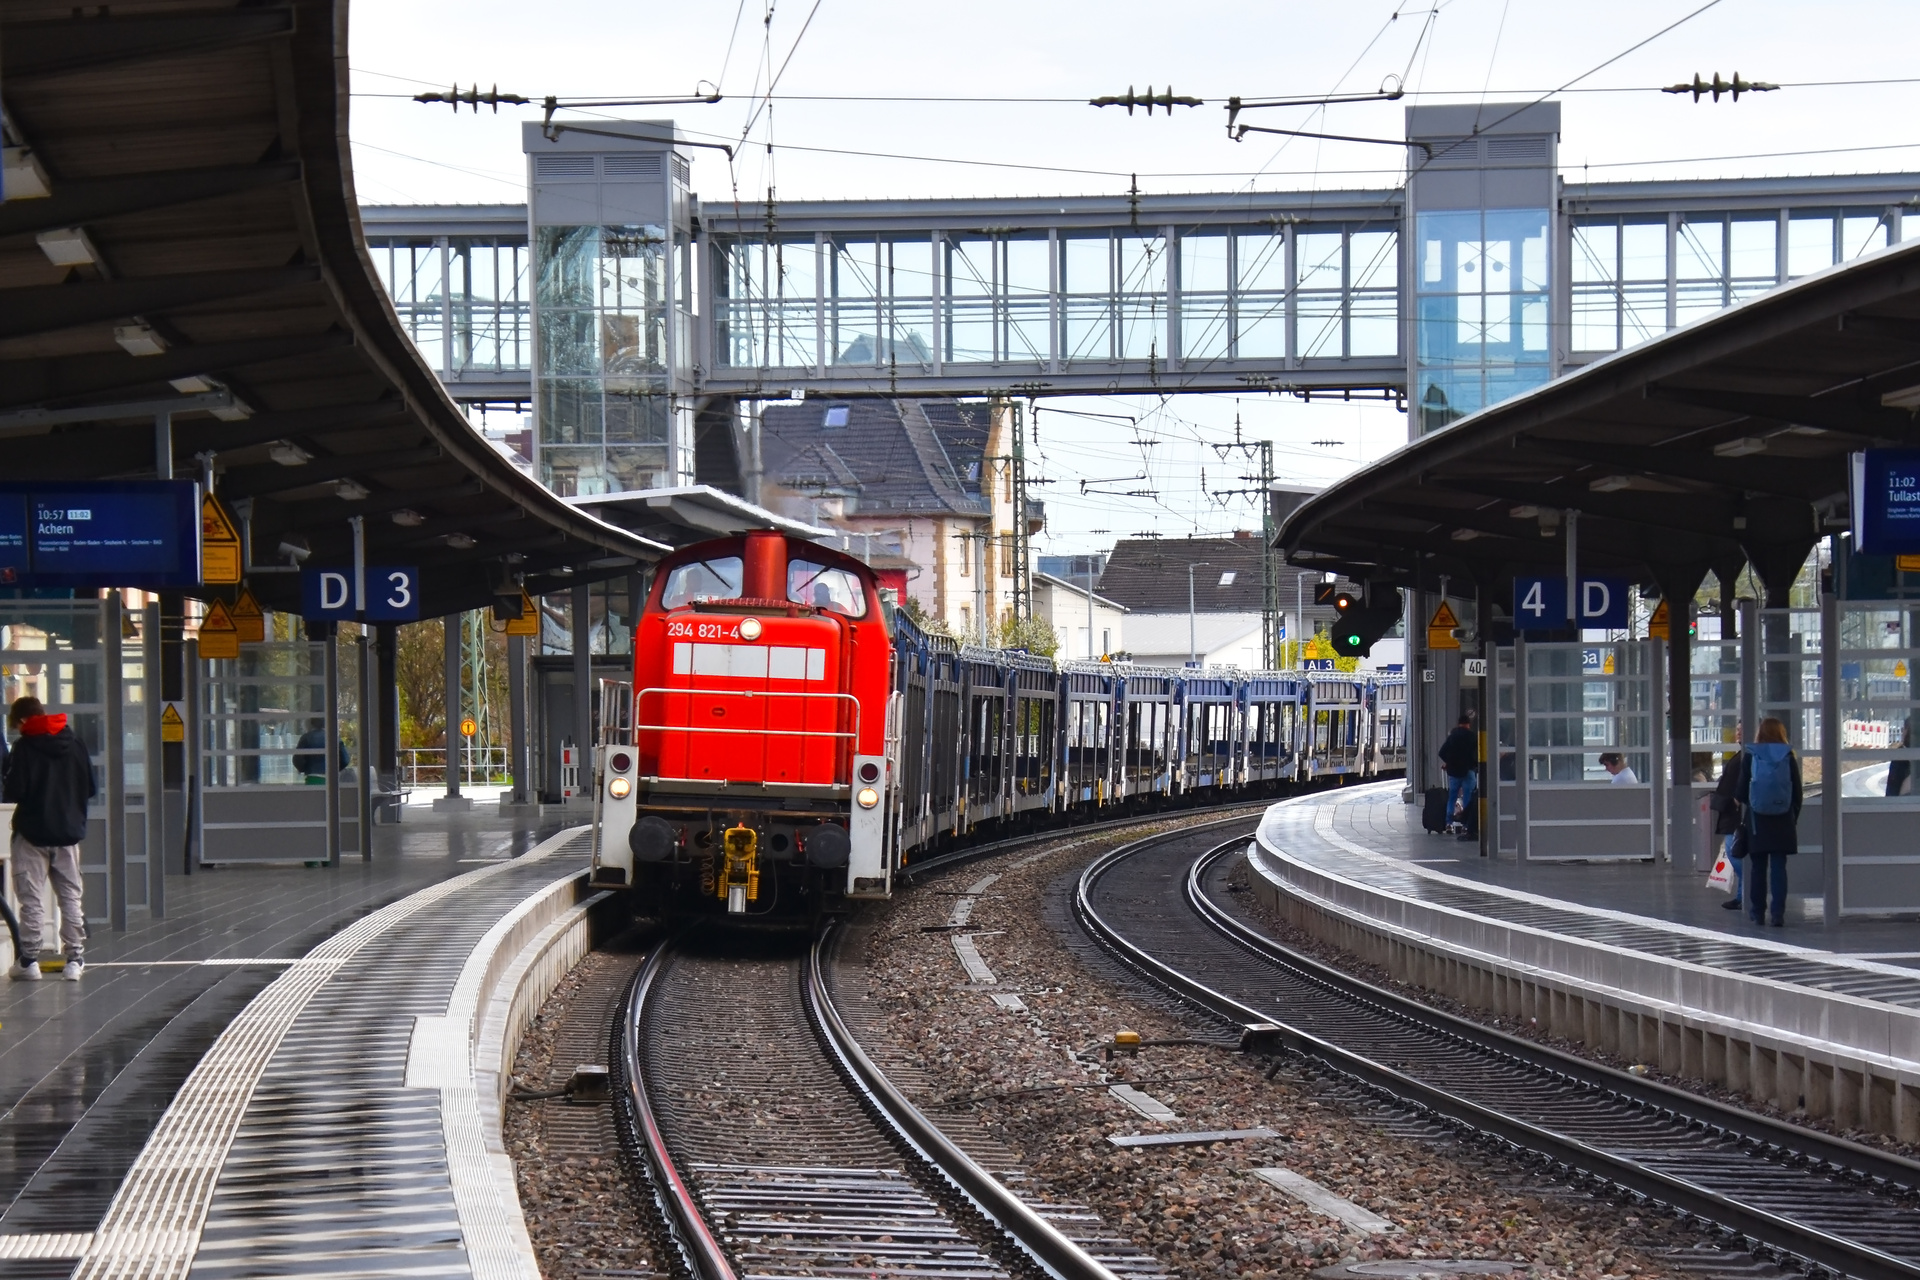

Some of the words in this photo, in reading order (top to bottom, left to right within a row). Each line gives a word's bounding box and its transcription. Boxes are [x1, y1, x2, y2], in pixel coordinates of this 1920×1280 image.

[1889, 477, 1915, 487] 11:02
[38, 510, 64, 520] 10:57
[38, 523, 74, 534] Achern
[320, 572, 348, 609] D
[386, 572, 411, 608] 3
[1521, 581, 1546, 618] 4
[1582, 581, 1610, 618] D
[668, 623, 693, 637] 294
[698, 624, 739, 639] 821-4
[1308, 660, 1316, 670] A
[1326, 660, 1332, 671] 3
[1426, 671, 1435, 680] 85
